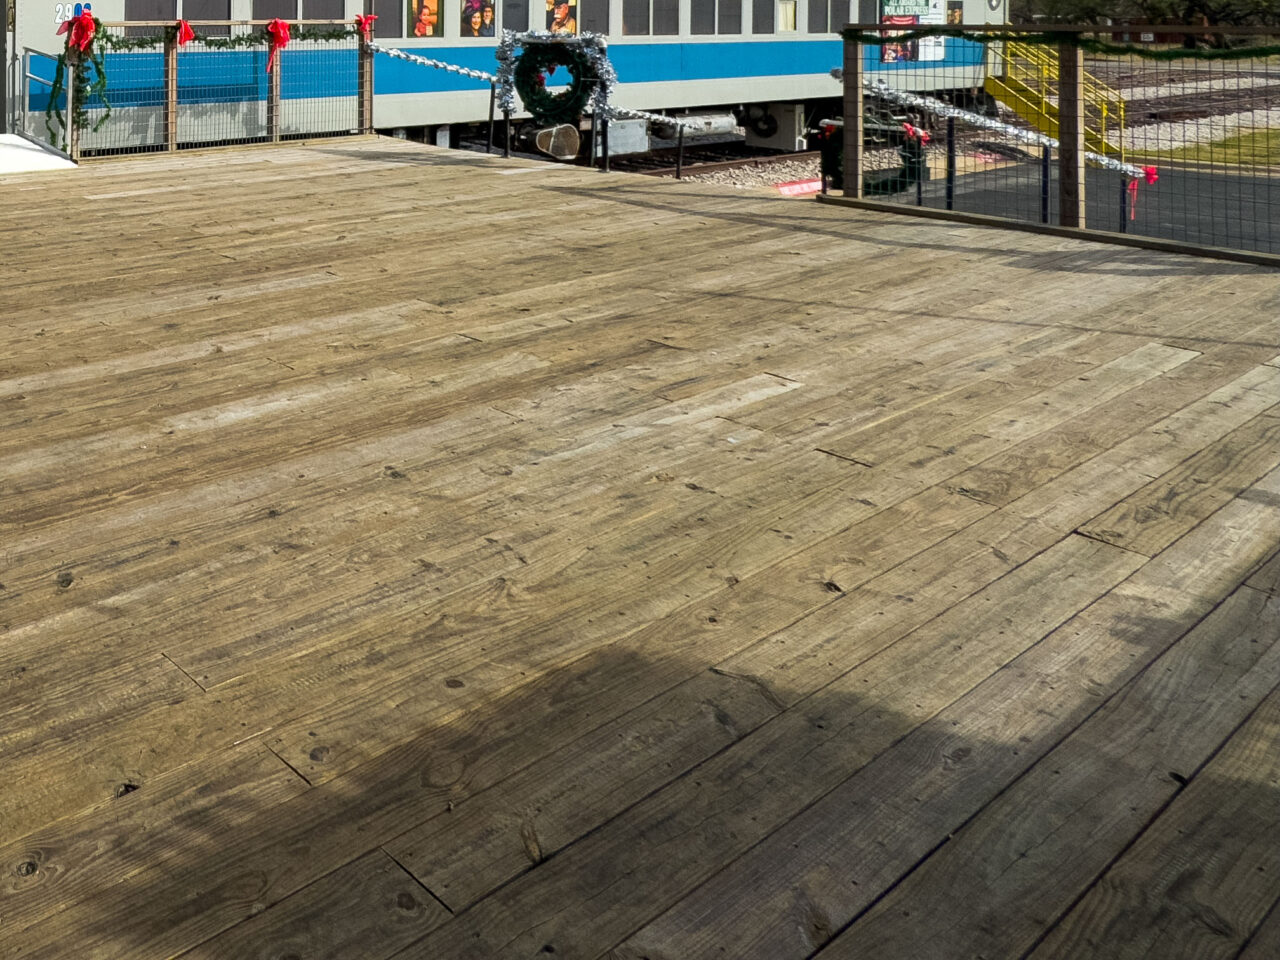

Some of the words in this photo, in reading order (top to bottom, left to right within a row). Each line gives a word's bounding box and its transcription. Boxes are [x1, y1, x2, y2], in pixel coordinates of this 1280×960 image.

[55, 2, 92, 24] 290
[884, 6, 905, 16] POLAR
[905, 6, 929, 16] EXPRESS
